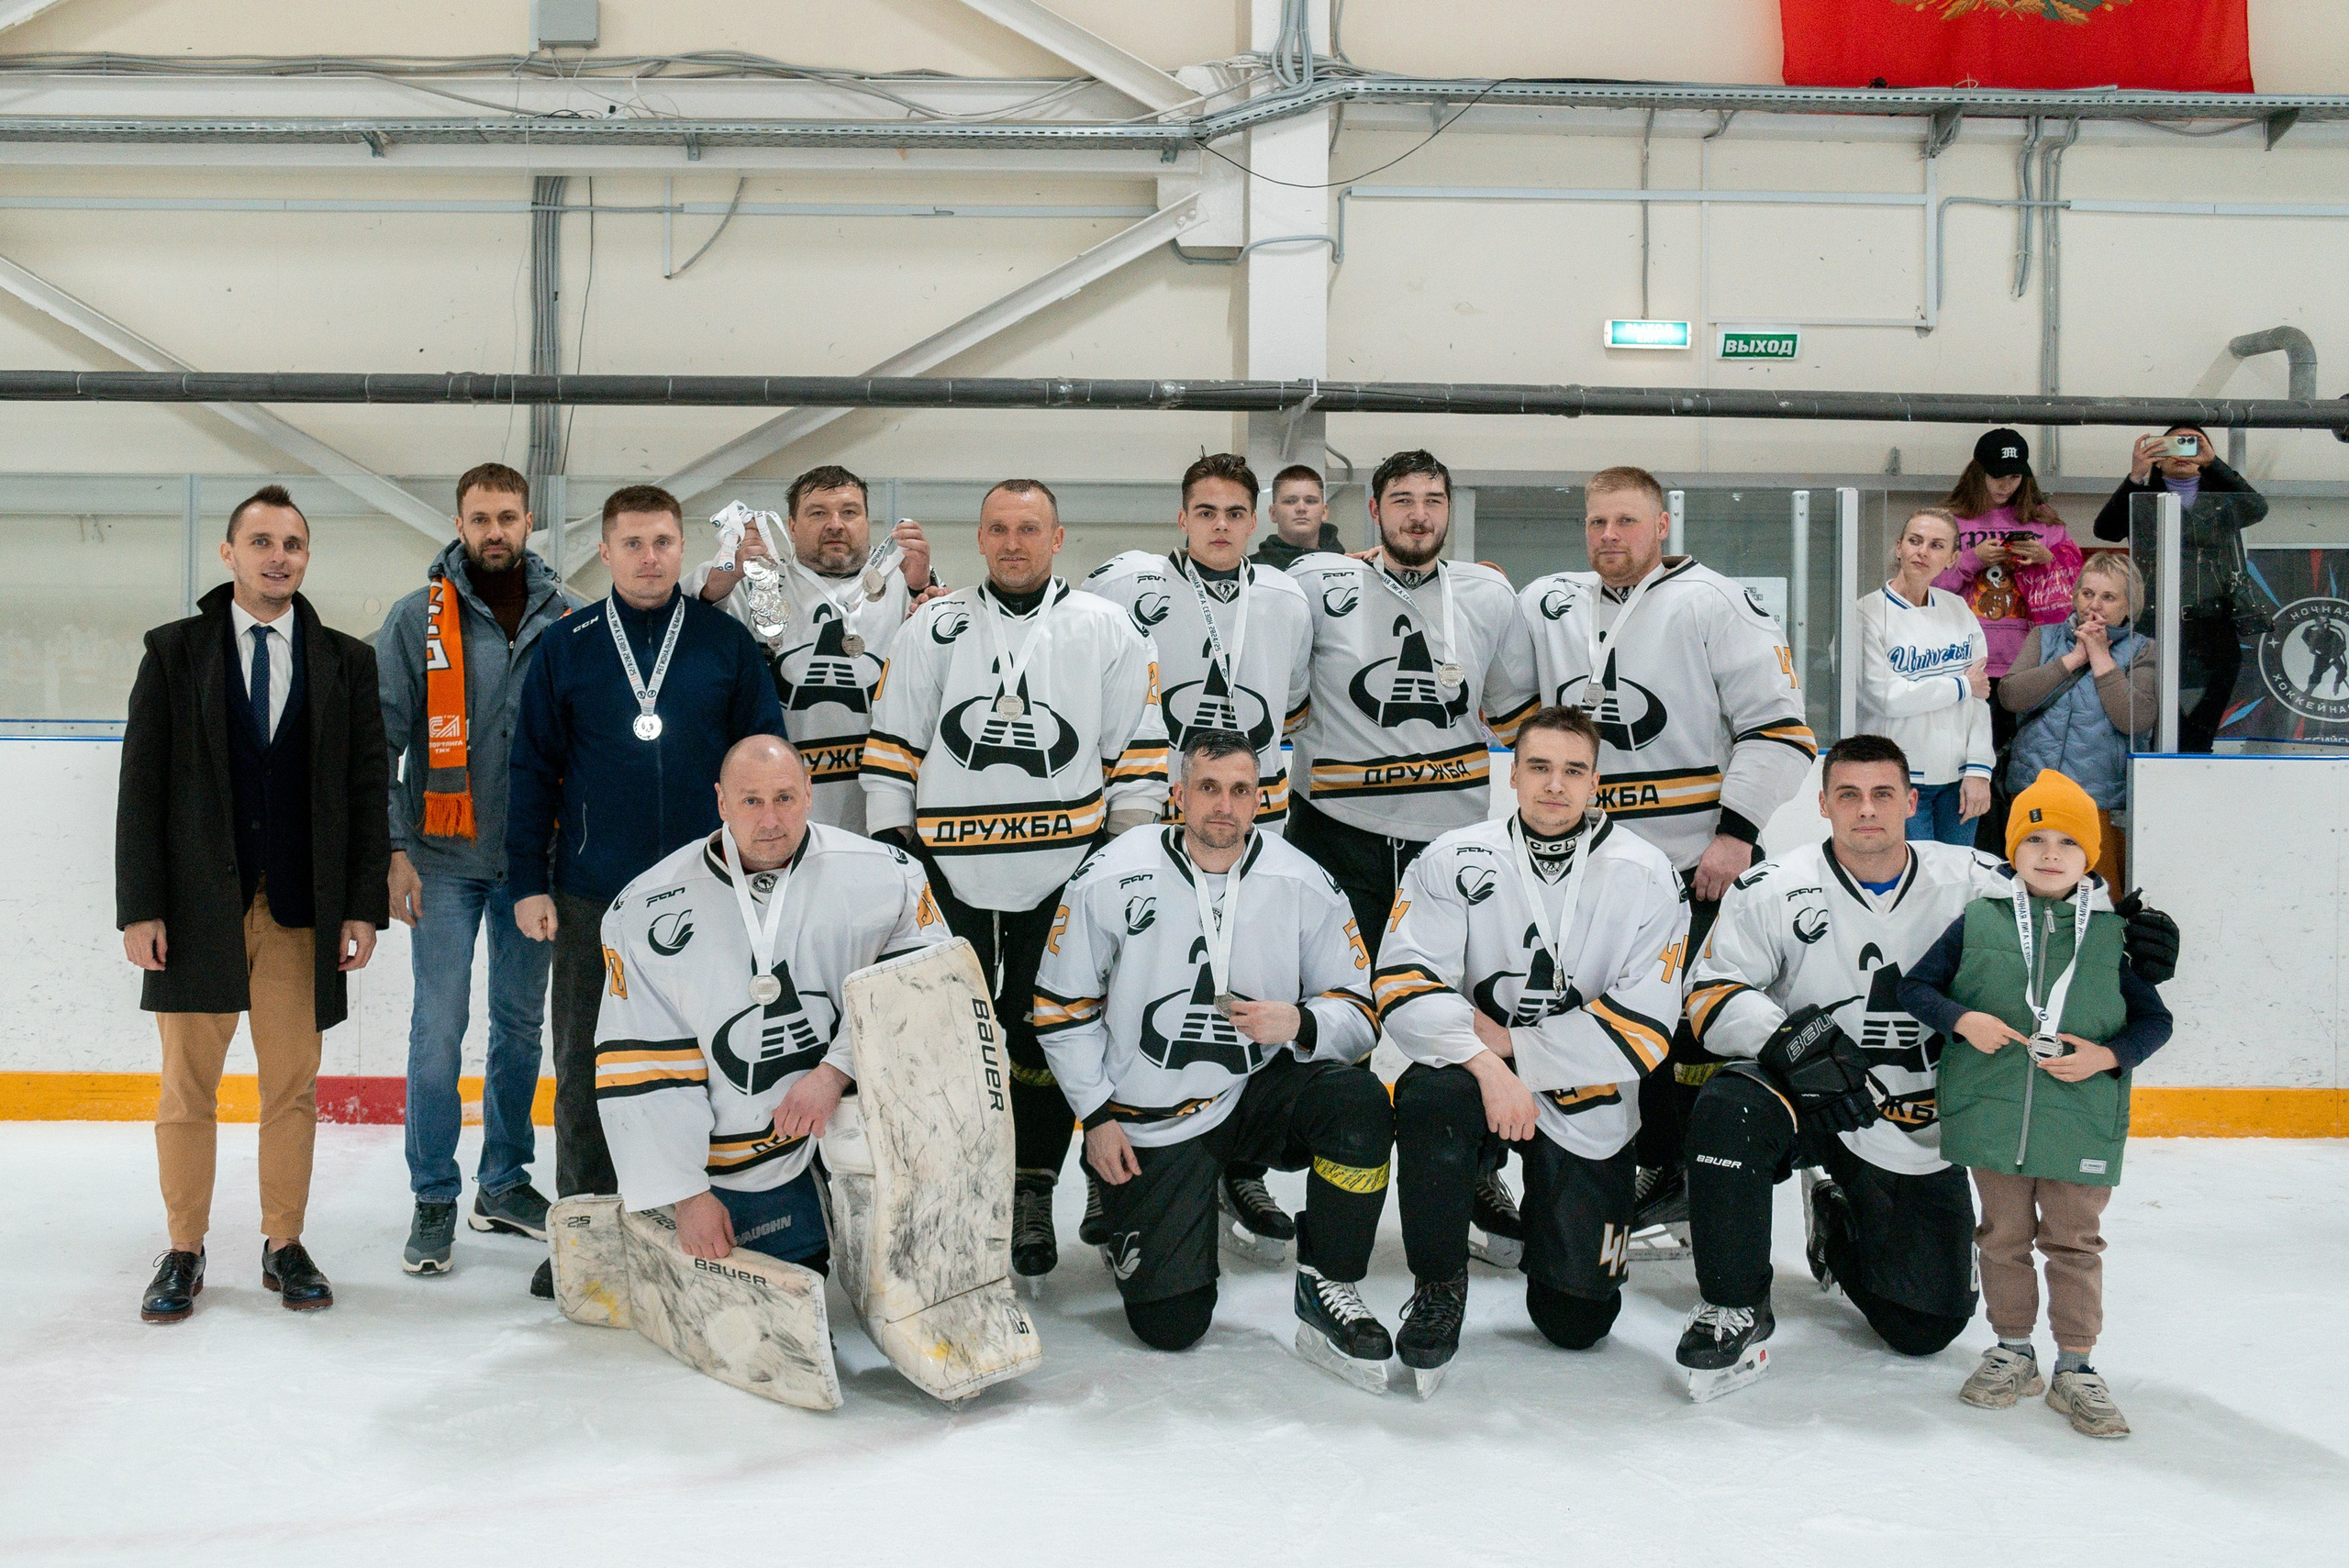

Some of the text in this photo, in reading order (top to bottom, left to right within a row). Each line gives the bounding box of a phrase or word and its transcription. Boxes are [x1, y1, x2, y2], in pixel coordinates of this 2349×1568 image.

[1725, 339, 1793, 355] ВЫХОД
[573, 616, 599, 633] CCM
[611, 619, 621, 633] ЛИГА
[1202, 606, 1213, 627] СЕЗОН
[616, 634, 629, 652] СЕЗОН
[655, 629, 676, 674] РЕГИОНАЛЬНЫЙ
[622, 651, 637, 676] 2024/25
[2273, 673, 2349, 714] ХОККЕЙНА
[1363, 759, 1471, 785] ДРУЖБА
[932, 814, 1073, 842] ДРУЖБА
[2016, 891, 2027, 919] НОЧНАЯ
[2077, 884, 2089, 925] ЧЕМПИОНАТ
[2021, 921, 2030, 940] ЛИГА
[972, 998, 1005, 1111] BAUER
[1697, 1154, 1742, 1169] BAUER
[695, 1258, 768, 1287] BAUER
